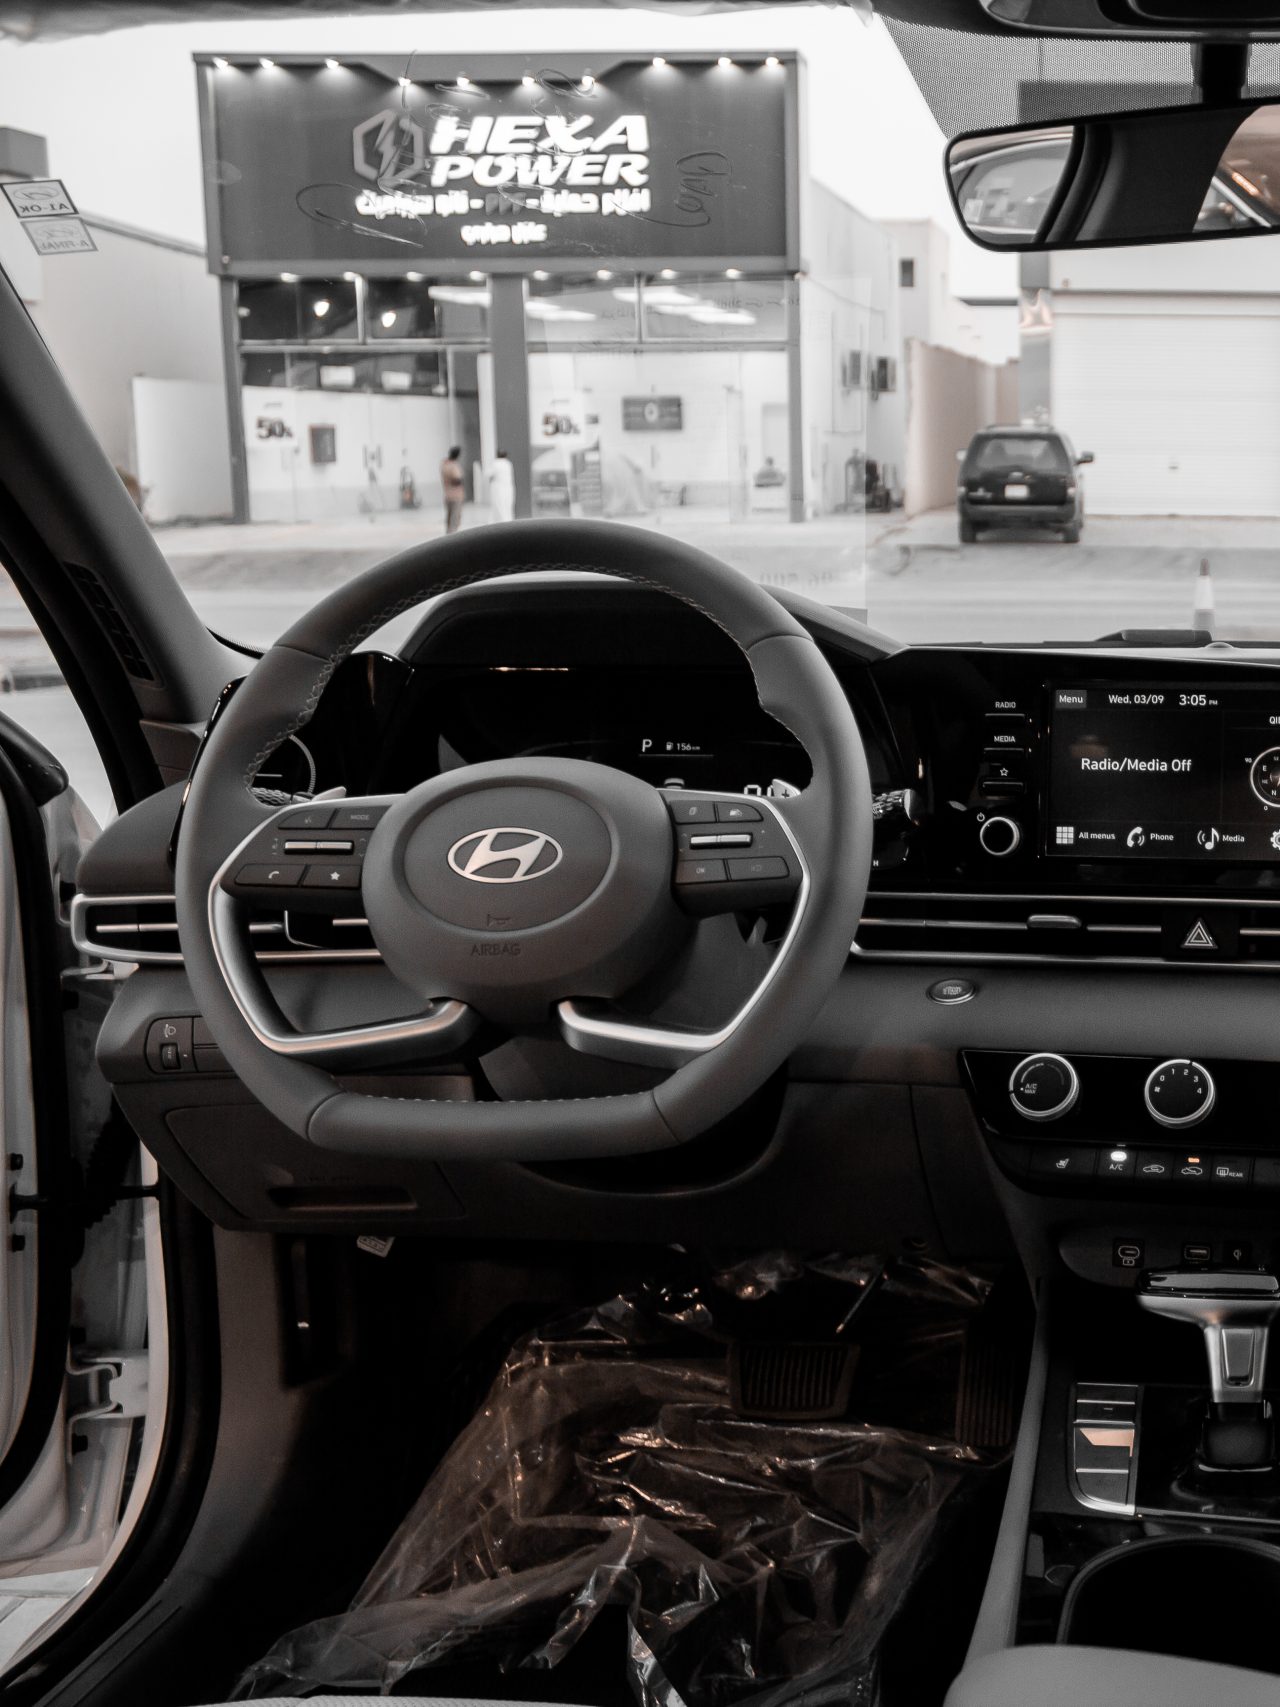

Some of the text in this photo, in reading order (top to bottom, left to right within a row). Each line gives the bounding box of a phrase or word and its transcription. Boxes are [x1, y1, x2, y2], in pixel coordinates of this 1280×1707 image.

[429, 114, 650, 155] HEXA
[429, 153, 651, 188] POWER
[1059, 695, 1083, 704] Menu
[1134, 694, 1164, 704] 03/09
[1179, 694, 1207, 706] 3:05
[993, 735, 1016, 743] MEDIA
[641, 739, 653, 753] P
[1081, 757, 1192, 772] Radio/Media Off
[1078, 831, 1089, 840] All
[1150, 833, 1174, 841] Phone
[1222, 834, 1245, 843] Media
[470, 943, 521, 956] AIRBAG
[1159, 1074, 1165, 1082] 0
[1171, 1068, 1175, 1076] 1
[1183, 1068, 1189, 1076] 2
[1193, 1075, 1199, 1083] 3
[1109, 1163, 1124, 1172] A/C
